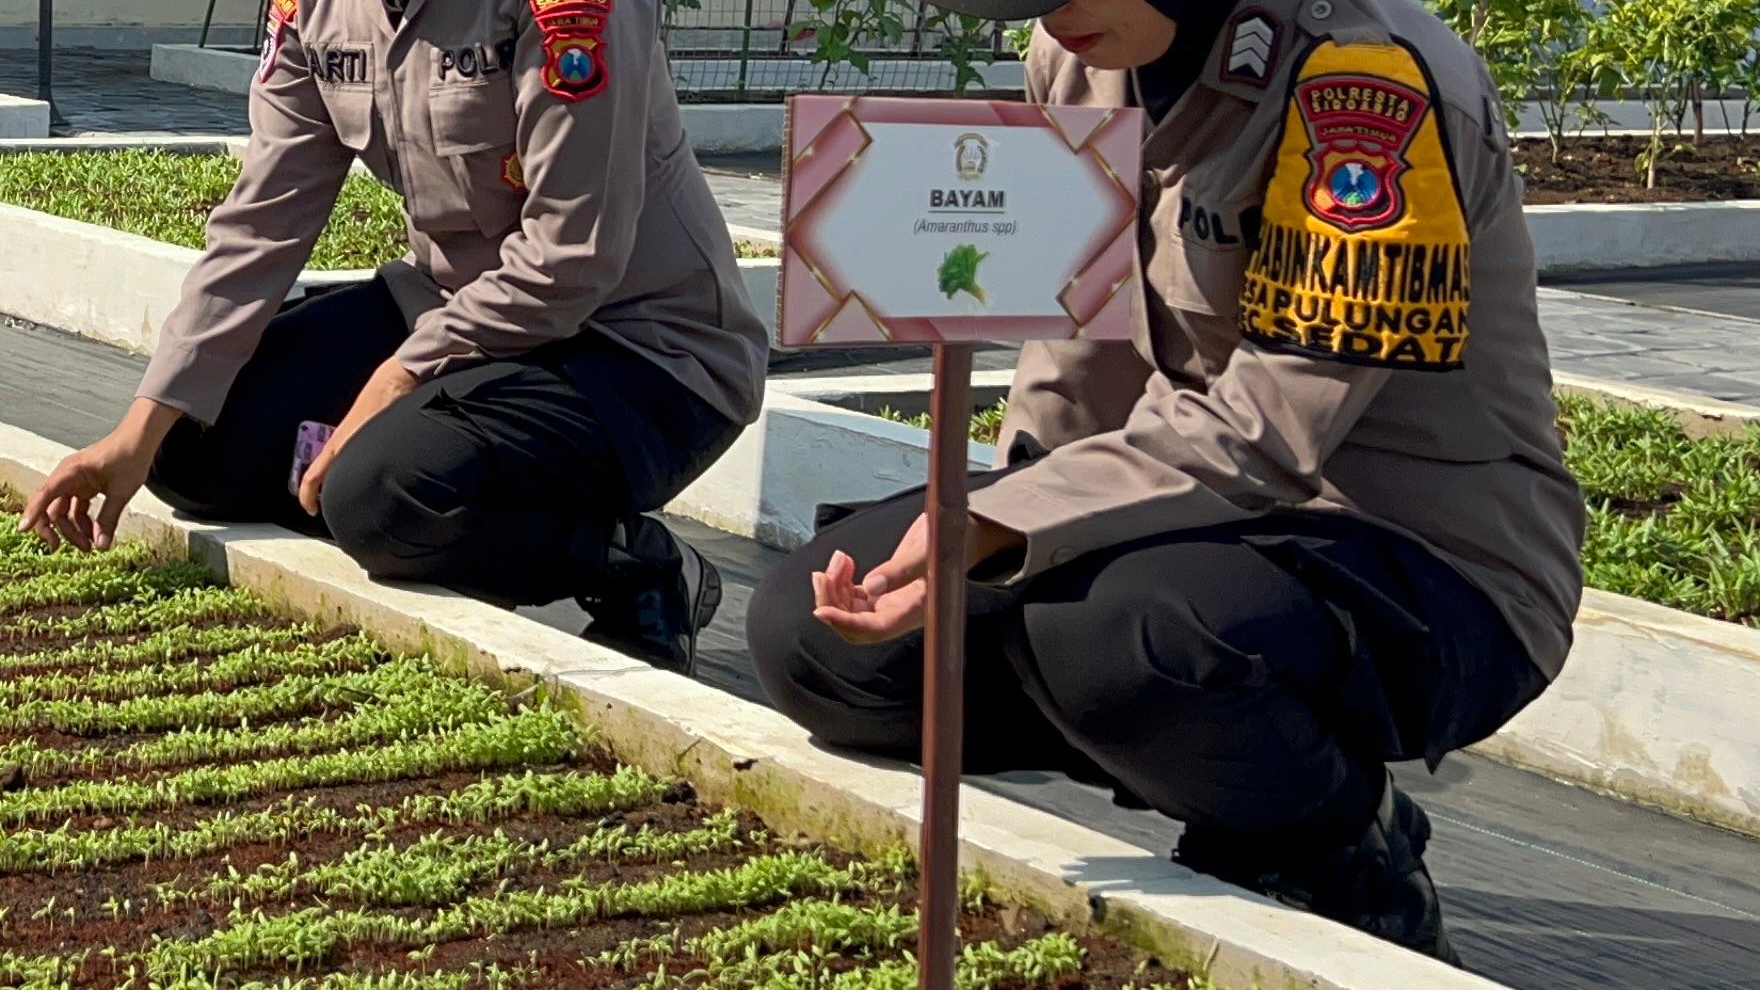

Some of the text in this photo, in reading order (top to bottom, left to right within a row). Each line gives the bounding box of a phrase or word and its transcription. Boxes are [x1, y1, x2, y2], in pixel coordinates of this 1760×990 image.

[1311, 87, 1410, 110] POLRESTA
[930, 189, 1005, 208] BAYAM
[913, 218, 1017, 235] (Amaranthus spp)
[1272, 316, 1468, 363] SEDAT
